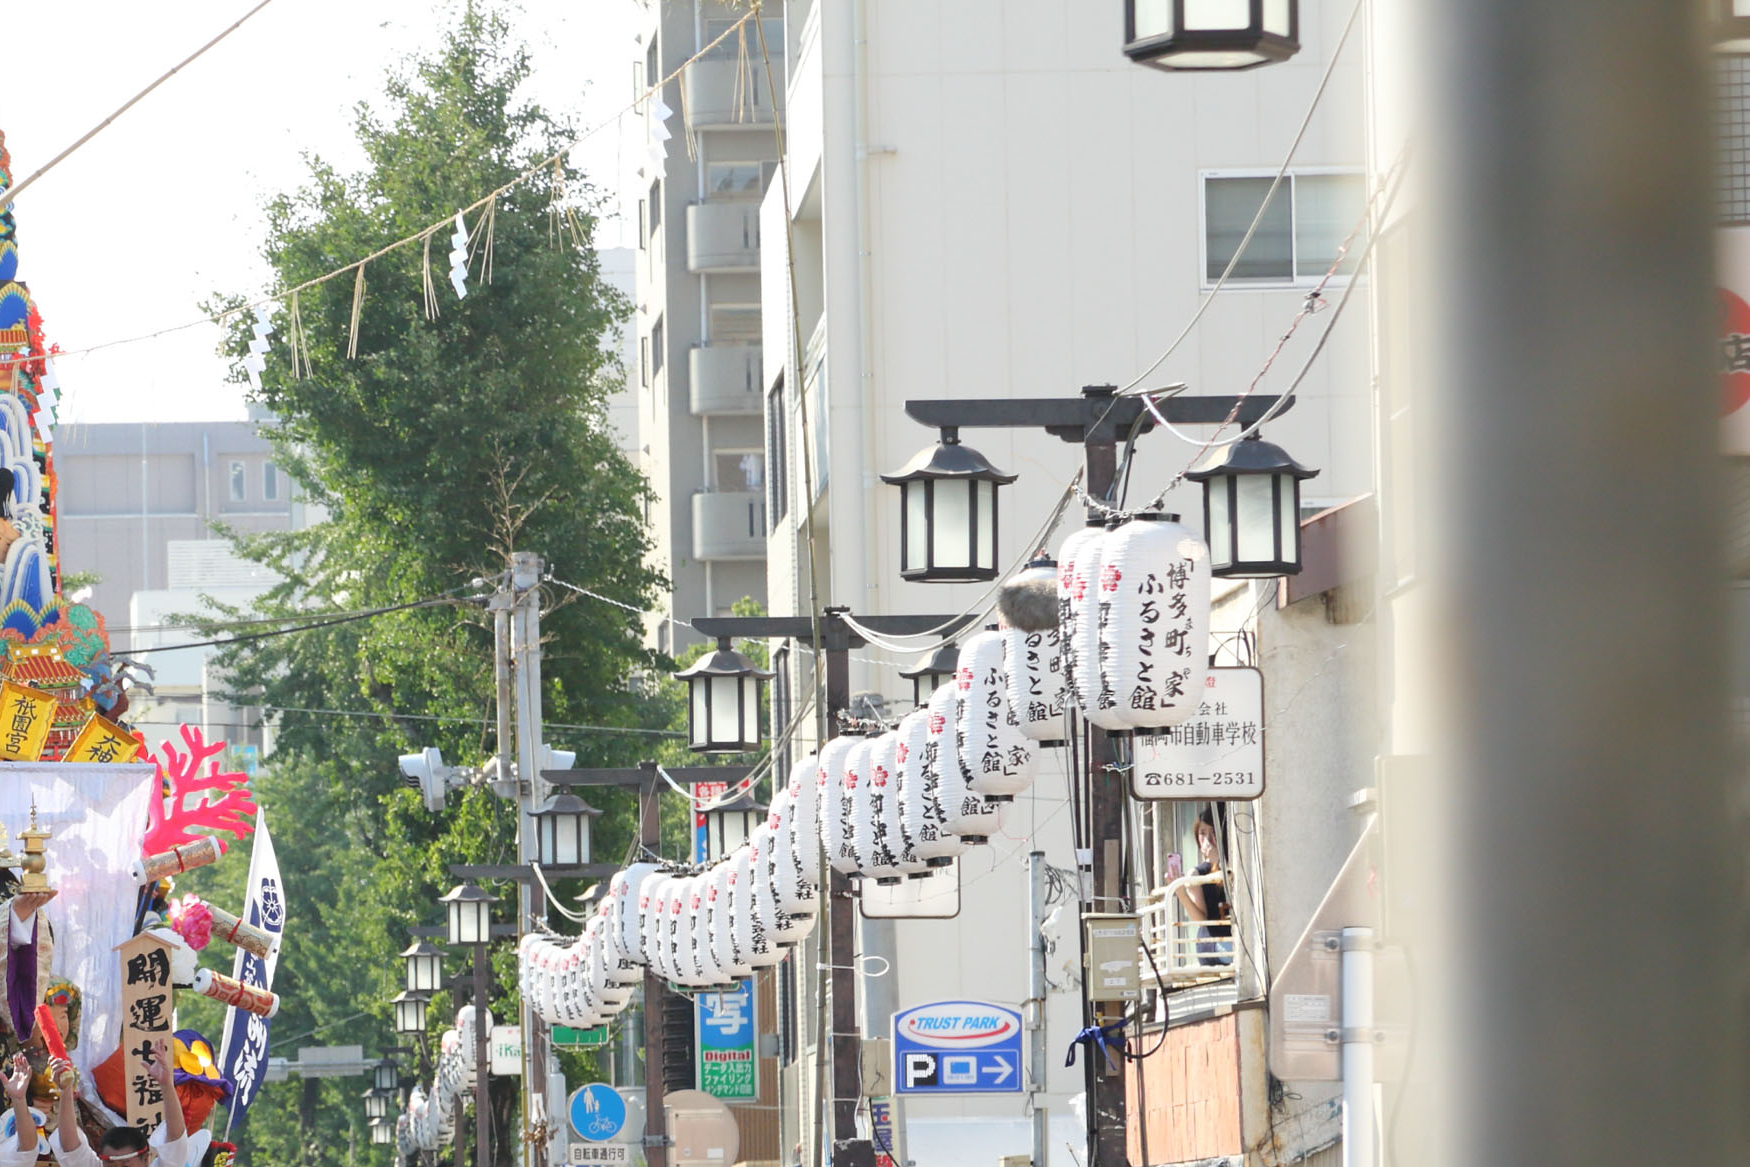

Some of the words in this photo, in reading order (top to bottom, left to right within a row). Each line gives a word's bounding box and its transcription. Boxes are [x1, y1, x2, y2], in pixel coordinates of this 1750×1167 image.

[1130, 573, 1164, 711] ふるさと館
[1024, 632, 1049, 722] るさと館
[6, 695, 37, 755] 祇園宮
[981, 667, 1004, 774] ふるさと館
[916, 1016, 961, 1030] TRUST
[962, 1016, 1000, 1030] PARK
[704, 1050, 751, 1063] Digital
[906, 1054, 937, 1088] P
[704, 1074, 752, 1085] ファイリング
[574, 1148, 625, 1161] 自転車通行可
